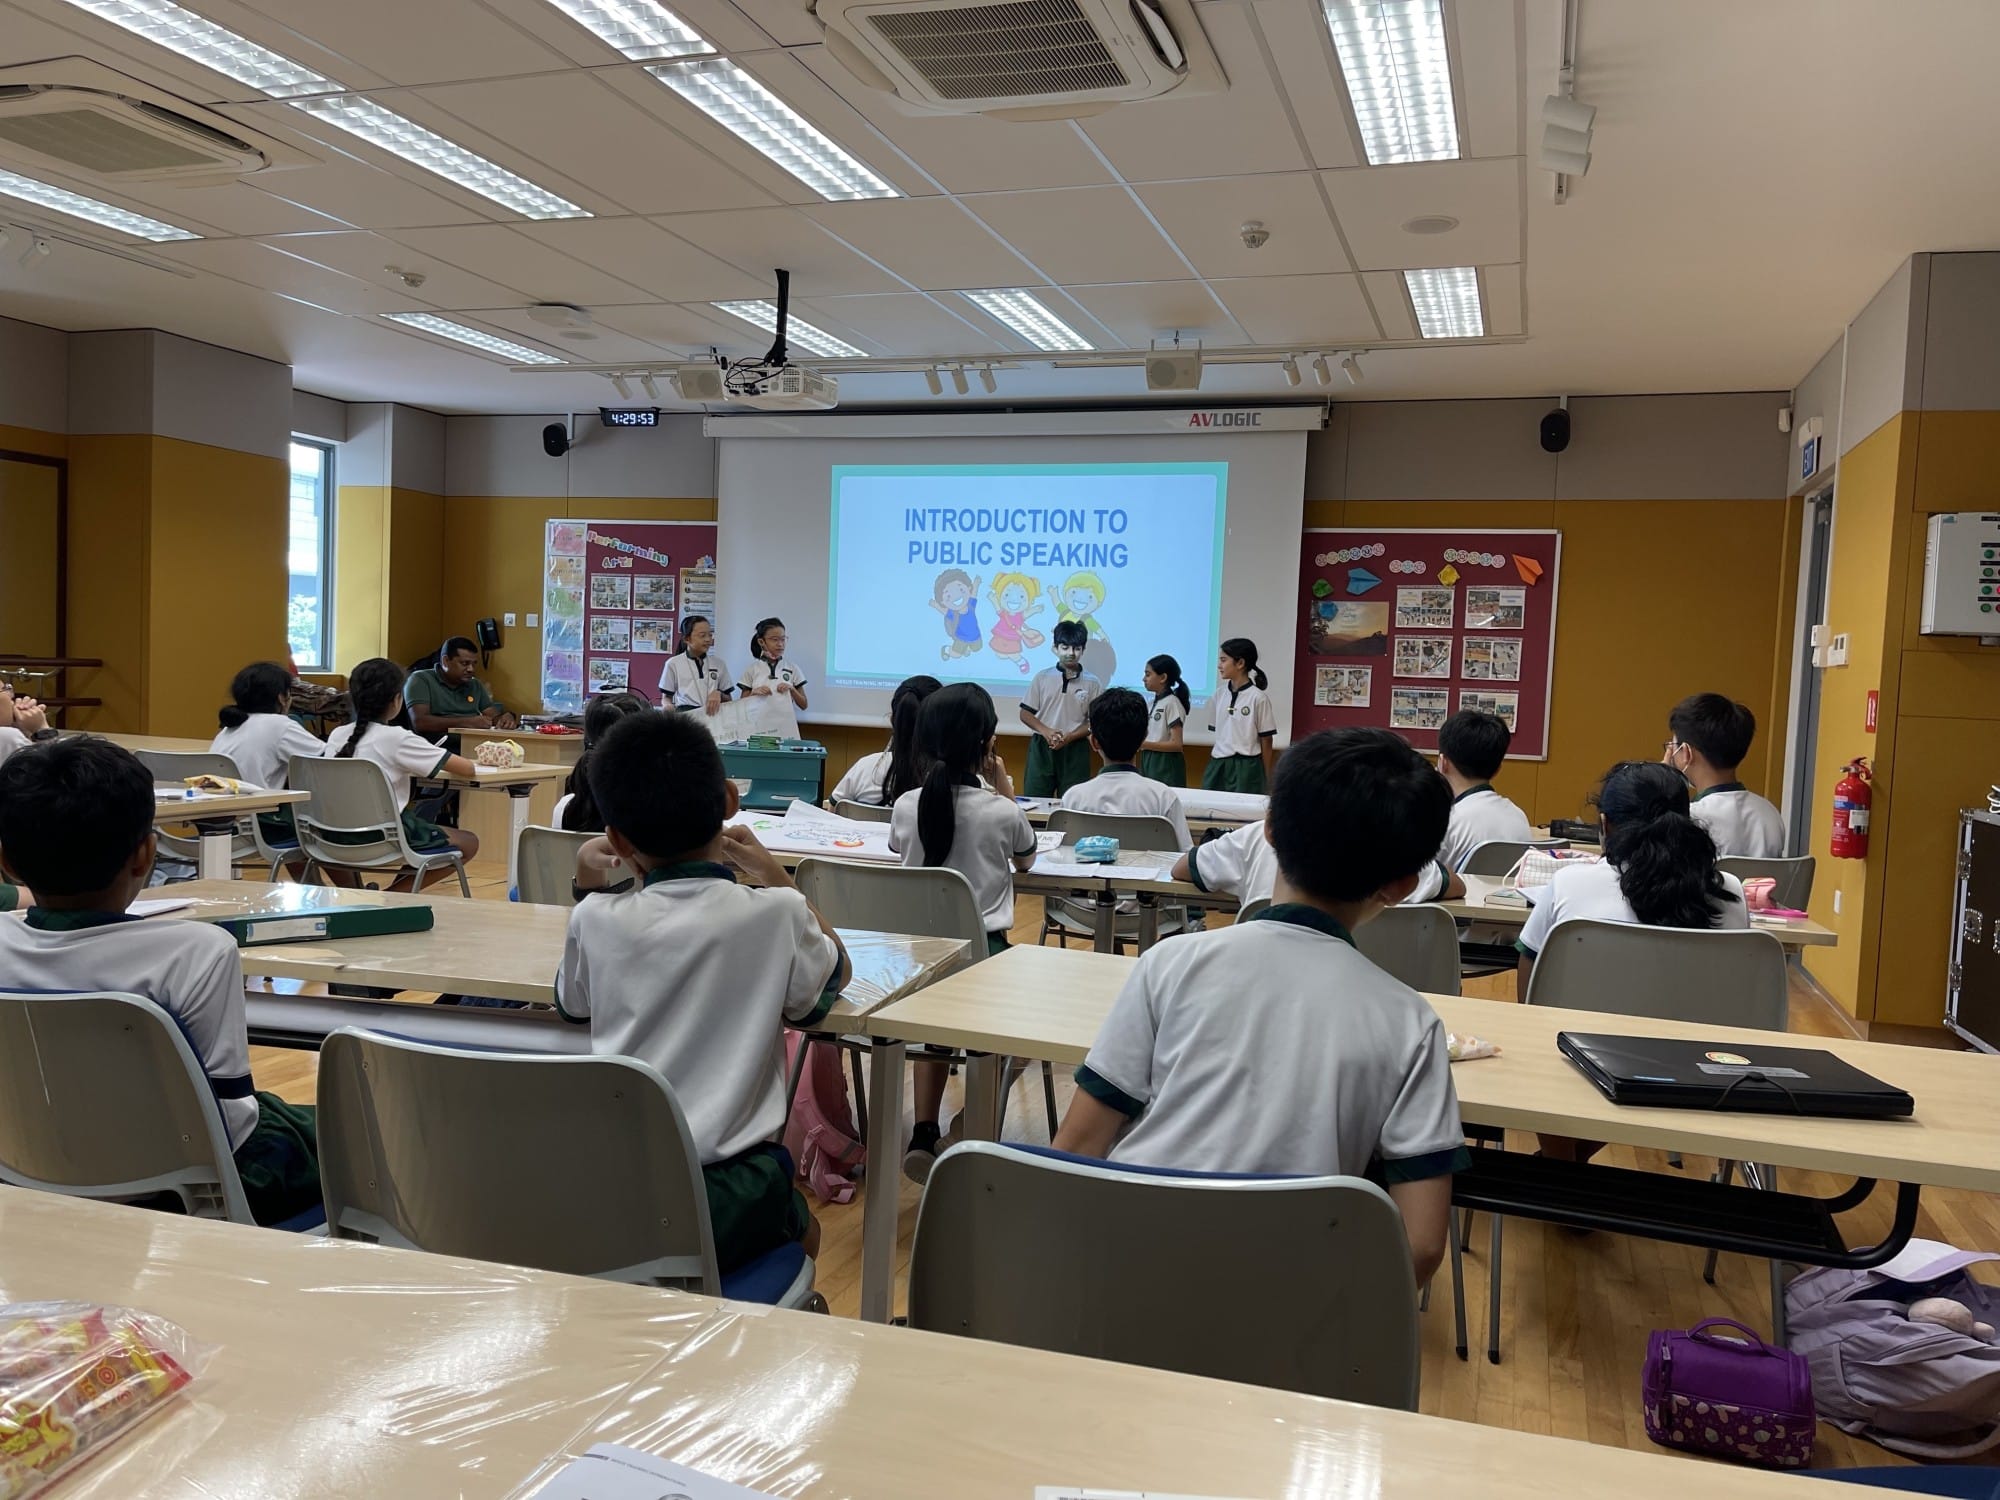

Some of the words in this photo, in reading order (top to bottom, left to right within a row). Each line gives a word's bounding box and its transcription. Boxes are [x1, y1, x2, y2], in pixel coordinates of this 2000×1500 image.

[611, 413, 654, 424] 4:29:53
[1189, 412, 1262, 427] AVLOGIC
[904, 508, 1085, 534] INTRODUCTION
[1093, 508, 1129, 534] TO
[907, 540, 993, 566] PUBLIC
[1000, 541, 1129, 568] SPEAKING
